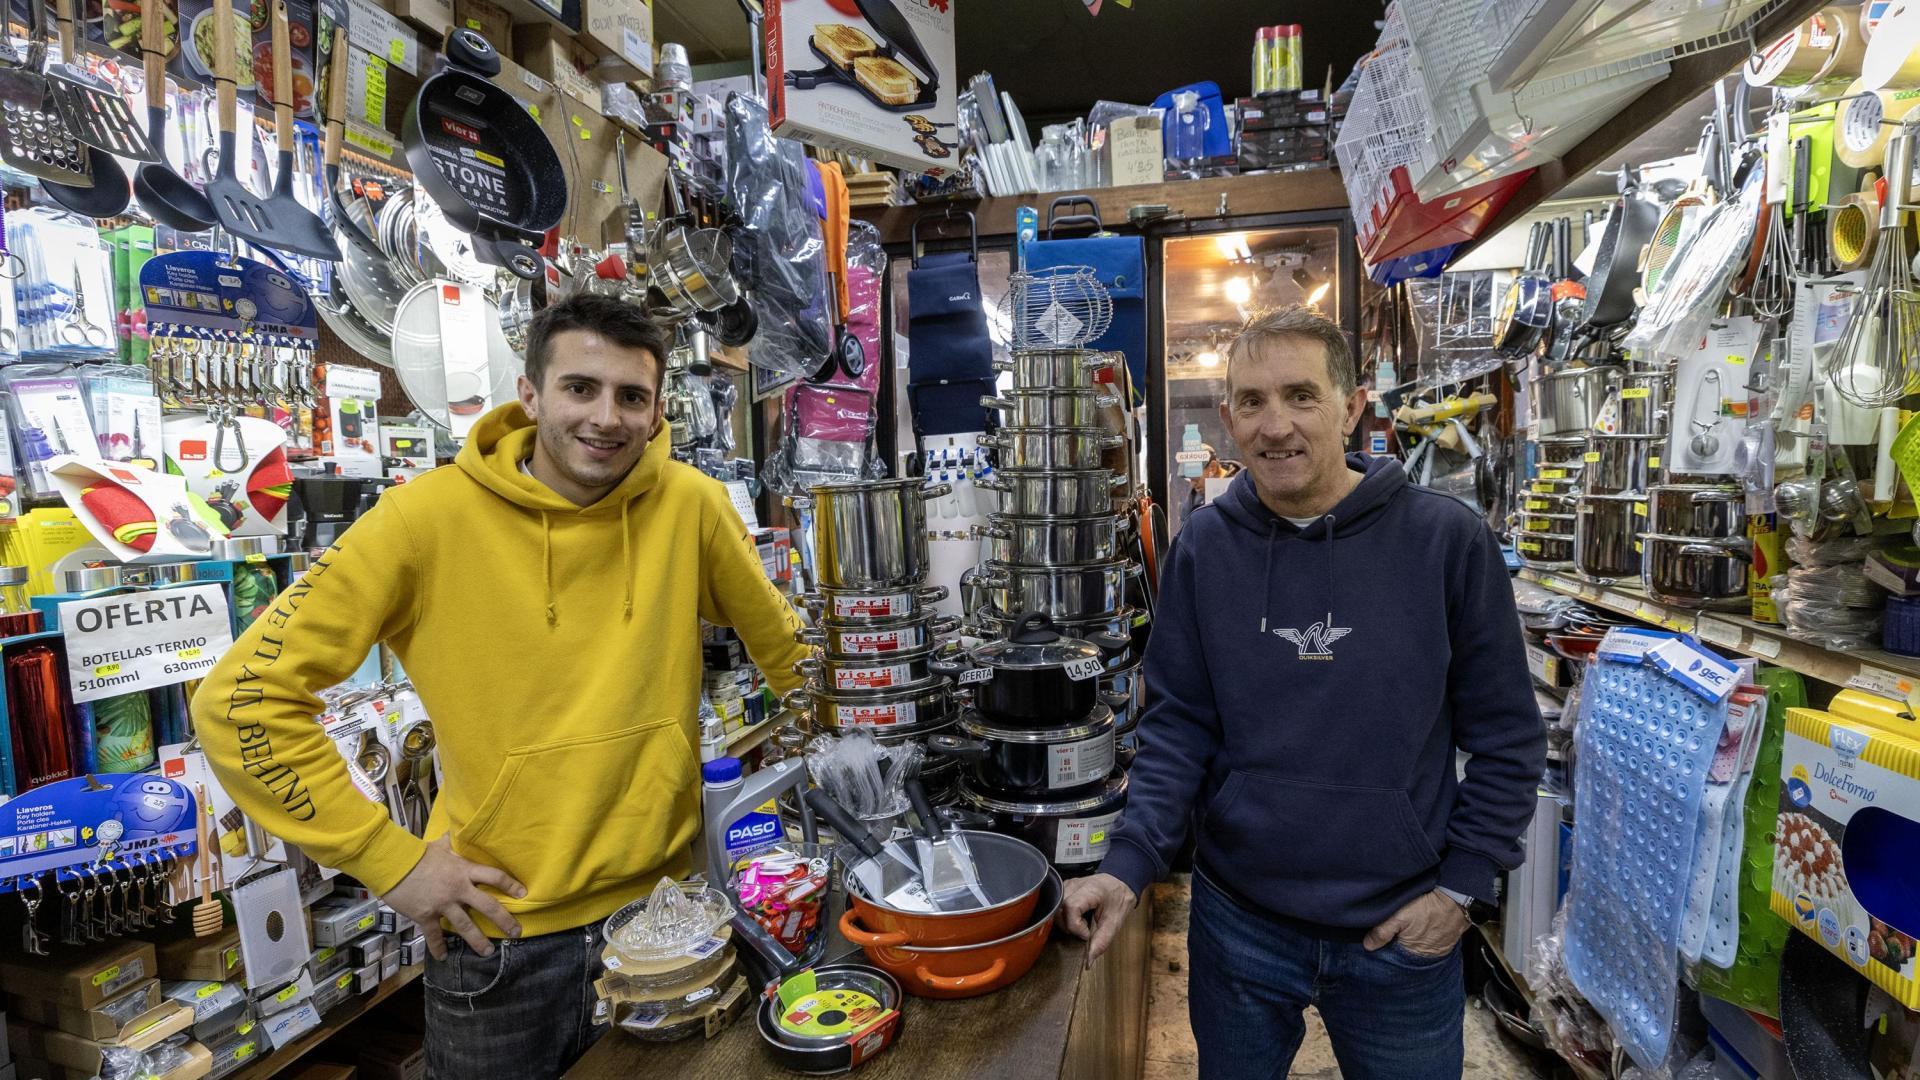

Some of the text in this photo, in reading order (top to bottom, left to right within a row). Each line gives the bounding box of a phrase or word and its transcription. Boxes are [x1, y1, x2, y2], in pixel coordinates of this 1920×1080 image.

[768, 21, 778, 70] GRILL
[431, 156, 506, 195] STONE
[260, 323, 288, 335] JMA
[76, 594, 213, 632] OFERTA
[82, 636, 207, 667] BOTELLAS TERMO
[253, 633, 283, 667] IT
[163, 656, 217, 674] 630mml
[1067, 660, 1101, 678] 14,90
[79, 670, 140, 691] 510mml
[959, 668, 993, 683] OFERTA
[1698, 666, 1726, 685] gsc
[1833, 728, 1862, 750] FLEX
[32, 769, 69, 784] quokka
[238, 720, 316, 821] BEHIND
[1814, 762, 1875, 802] DolceForno
[16, 804, 53, 815] Llaveros
[31, 810, 56, 818] holders
[17, 818, 34, 826] Porte
[17, 818, 72, 832] Karabiner-Haken
[729, 821, 776, 841] PASO
[124, 838, 159, 851] JMA
